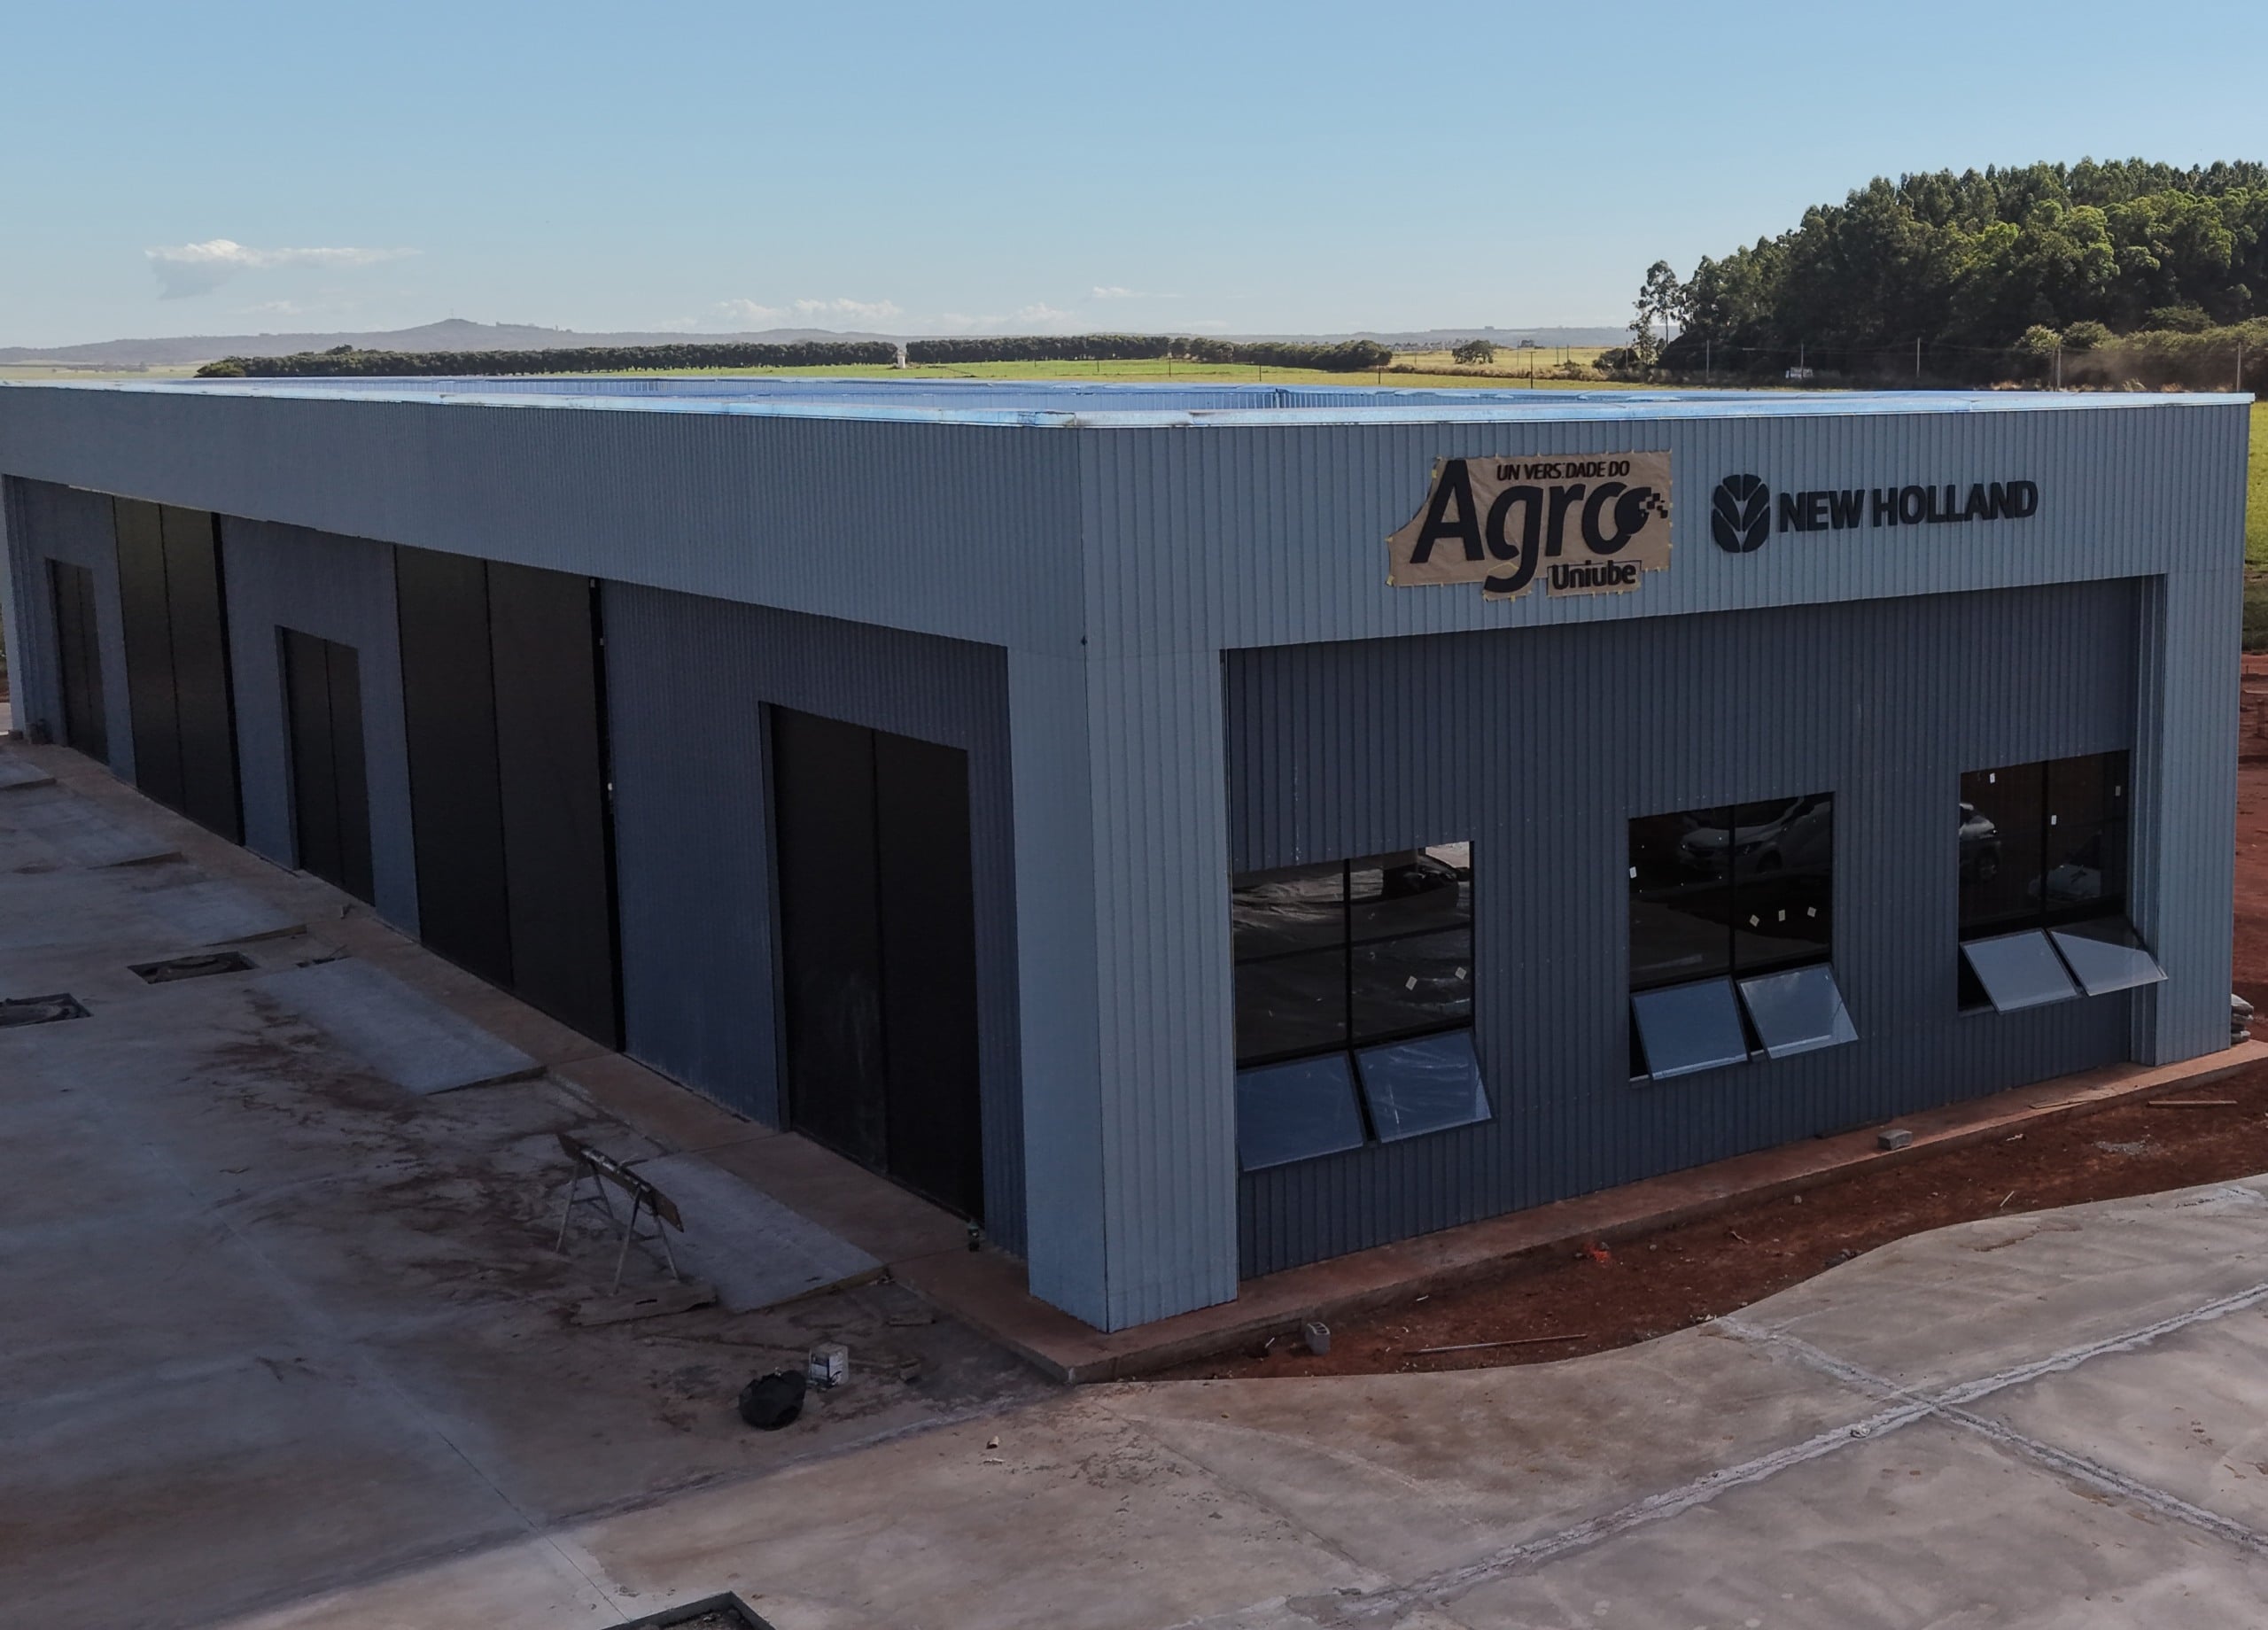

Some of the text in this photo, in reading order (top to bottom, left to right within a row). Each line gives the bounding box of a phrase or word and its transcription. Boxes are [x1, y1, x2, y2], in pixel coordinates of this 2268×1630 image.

[1496, 460, 1630, 481] UNVERSDADE DO
[1410, 459, 1651, 593] Agro
[1779, 480, 2039, 532] NEW HOLLAND
[1551, 559, 1636, 590] Uniube
